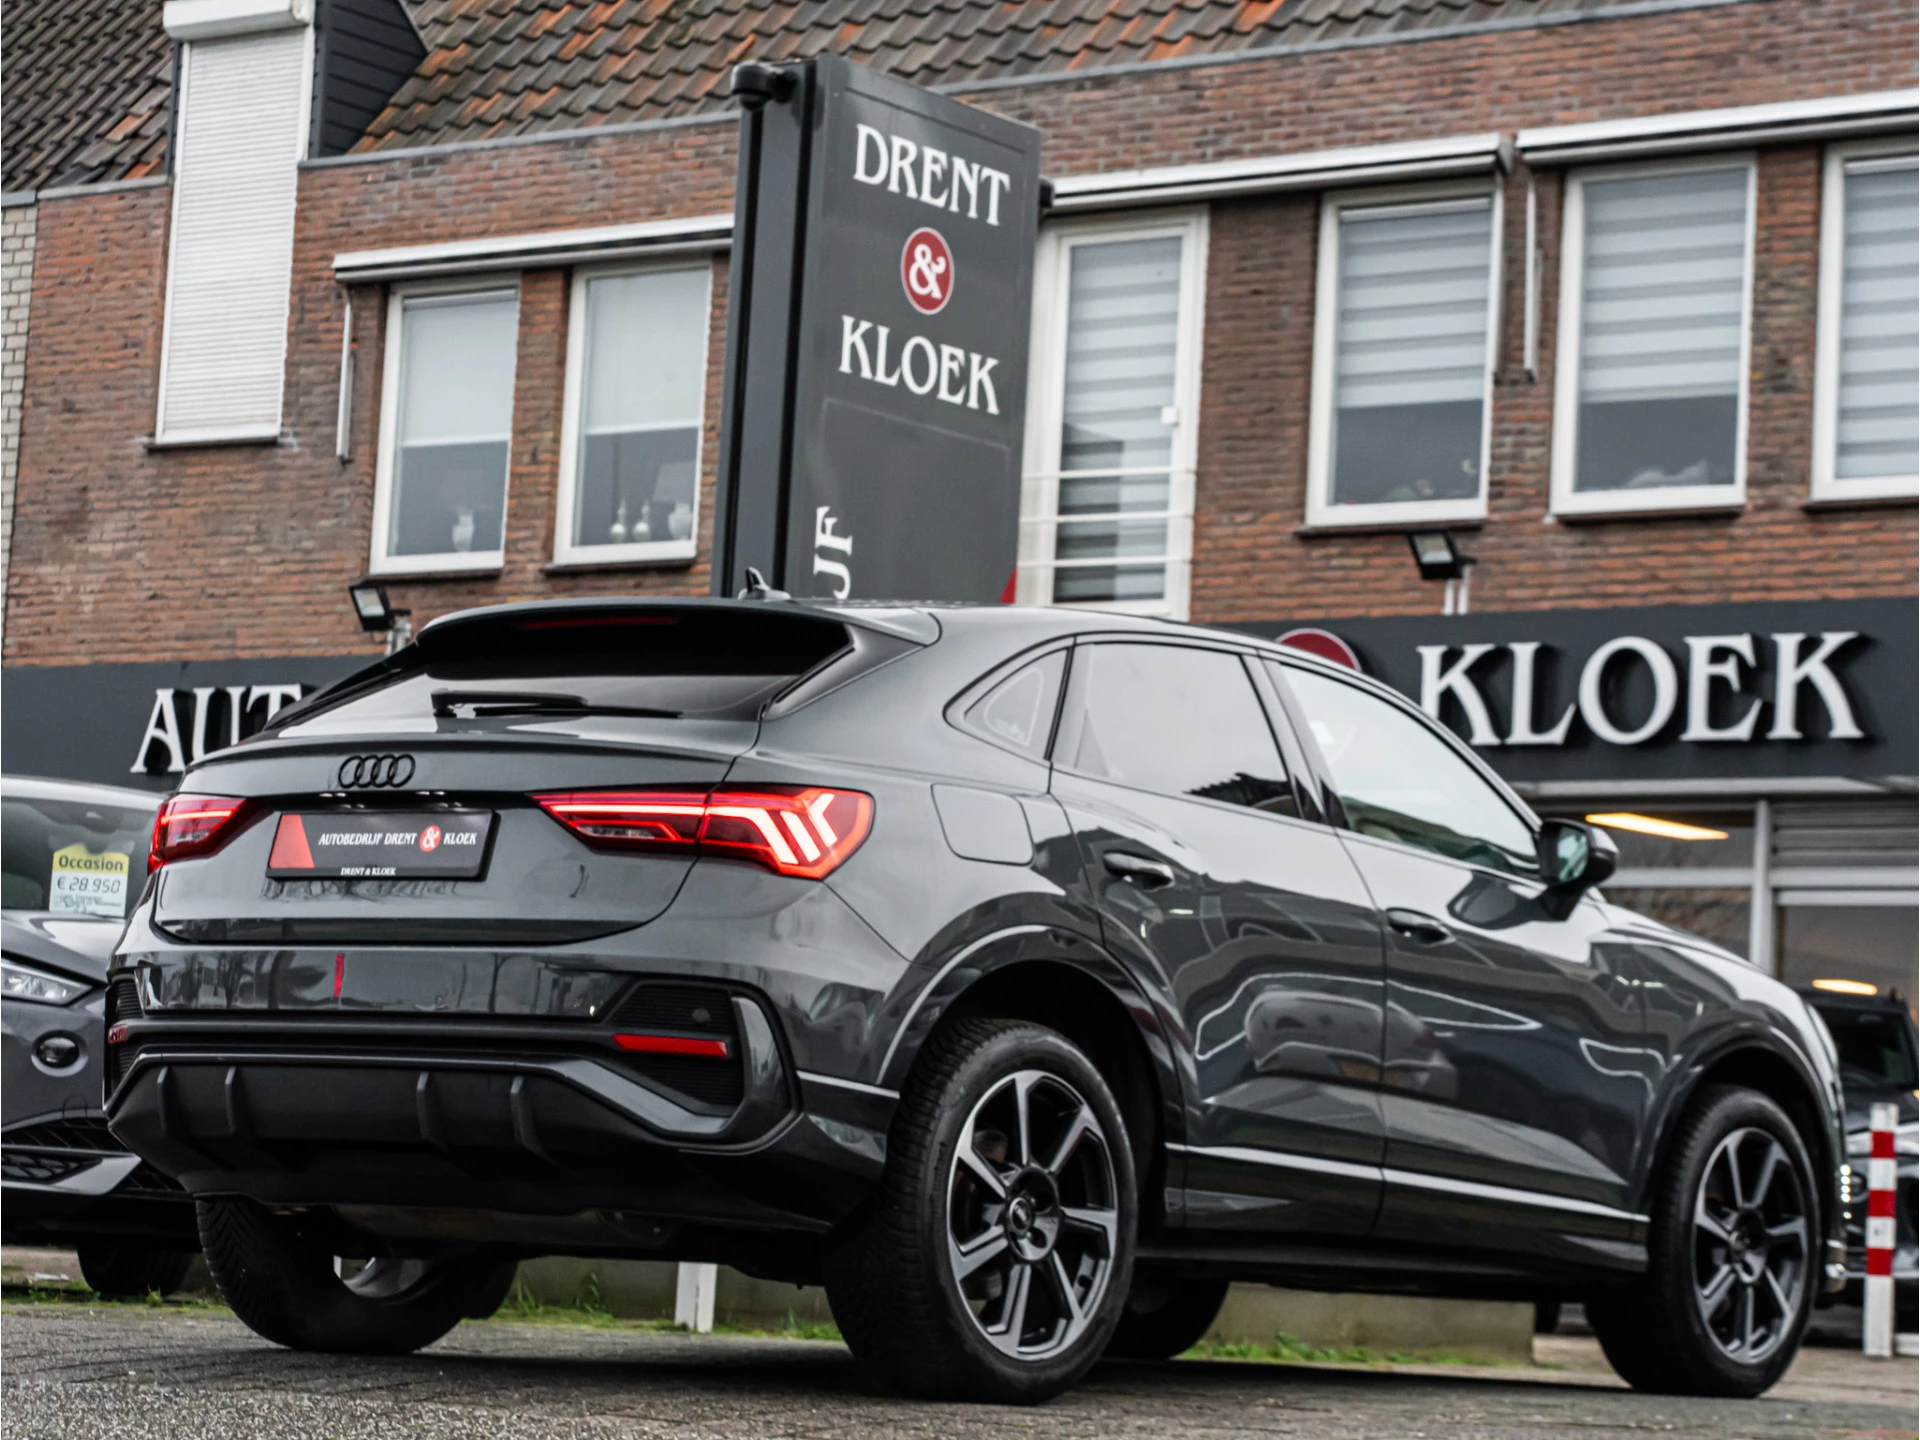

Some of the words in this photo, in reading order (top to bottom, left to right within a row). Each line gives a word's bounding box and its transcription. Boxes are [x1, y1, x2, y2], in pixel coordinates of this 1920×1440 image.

[853, 123, 1010, 226] DRENT
[909, 244, 946, 299] &
[838, 315, 999, 415] KLOEK
[1416, 631, 1864, 745] KLOEK
[318, 832, 381, 846] AUTOBEDRIJF
[384, 832, 417, 845] DRENT
[422, 827, 440, 849] &
[443, 832, 477, 845] KLOEK
[58, 855, 123, 871] Occasion
[340, 867, 365, 876] DRENT
[365, 868, 371, 876] &
[371, 867, 396, 876] KLOEK
[57, 876, 66, 890] €
